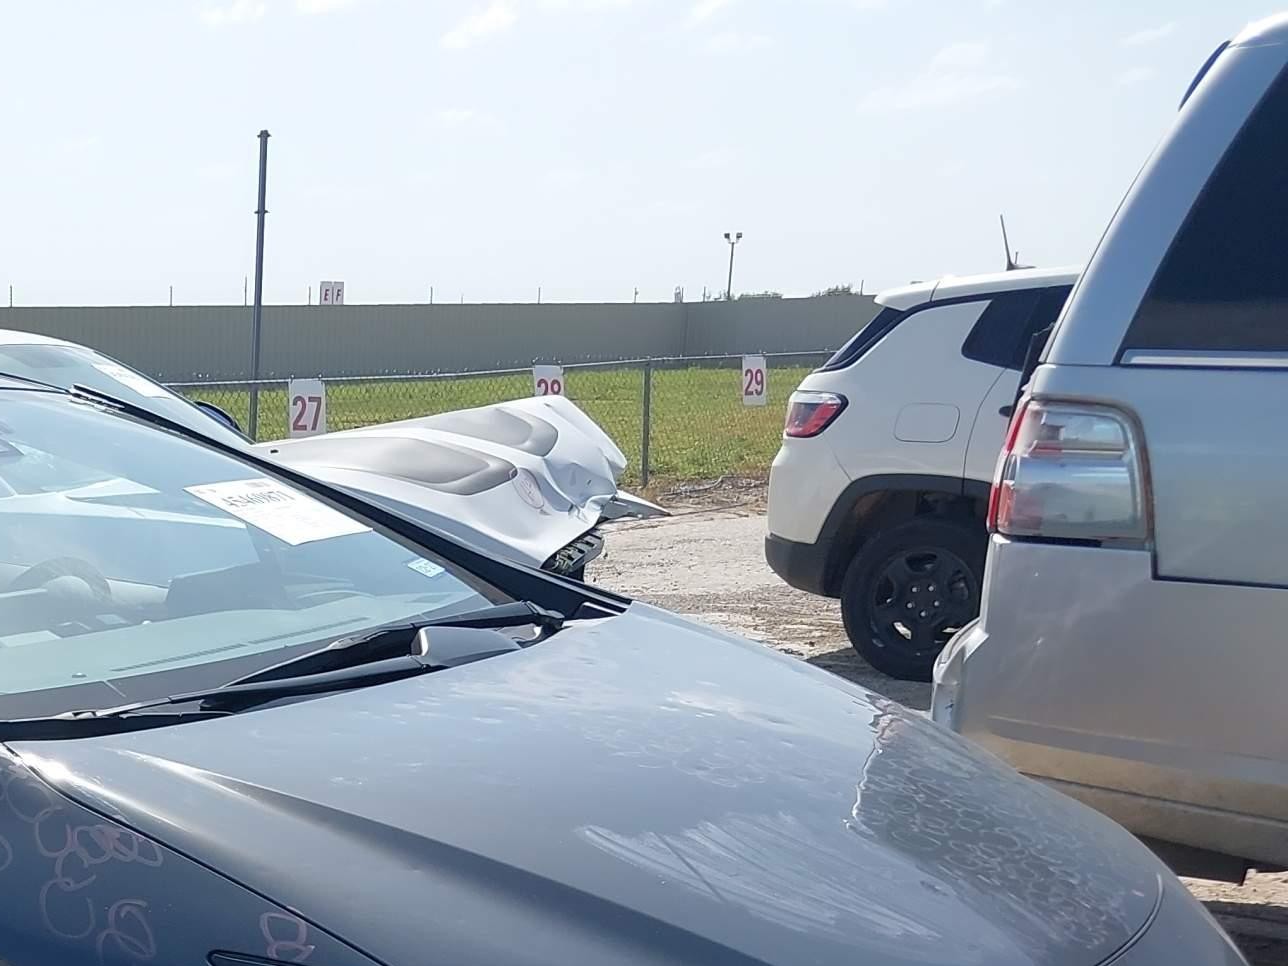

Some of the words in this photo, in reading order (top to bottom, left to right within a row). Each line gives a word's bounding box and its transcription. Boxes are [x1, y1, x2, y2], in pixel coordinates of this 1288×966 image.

[323, 288, 330, 301] E
[335, 288, 342, 301] F
[744, 368, 764, 396] 29
[292, 395, 322, 431] 27
